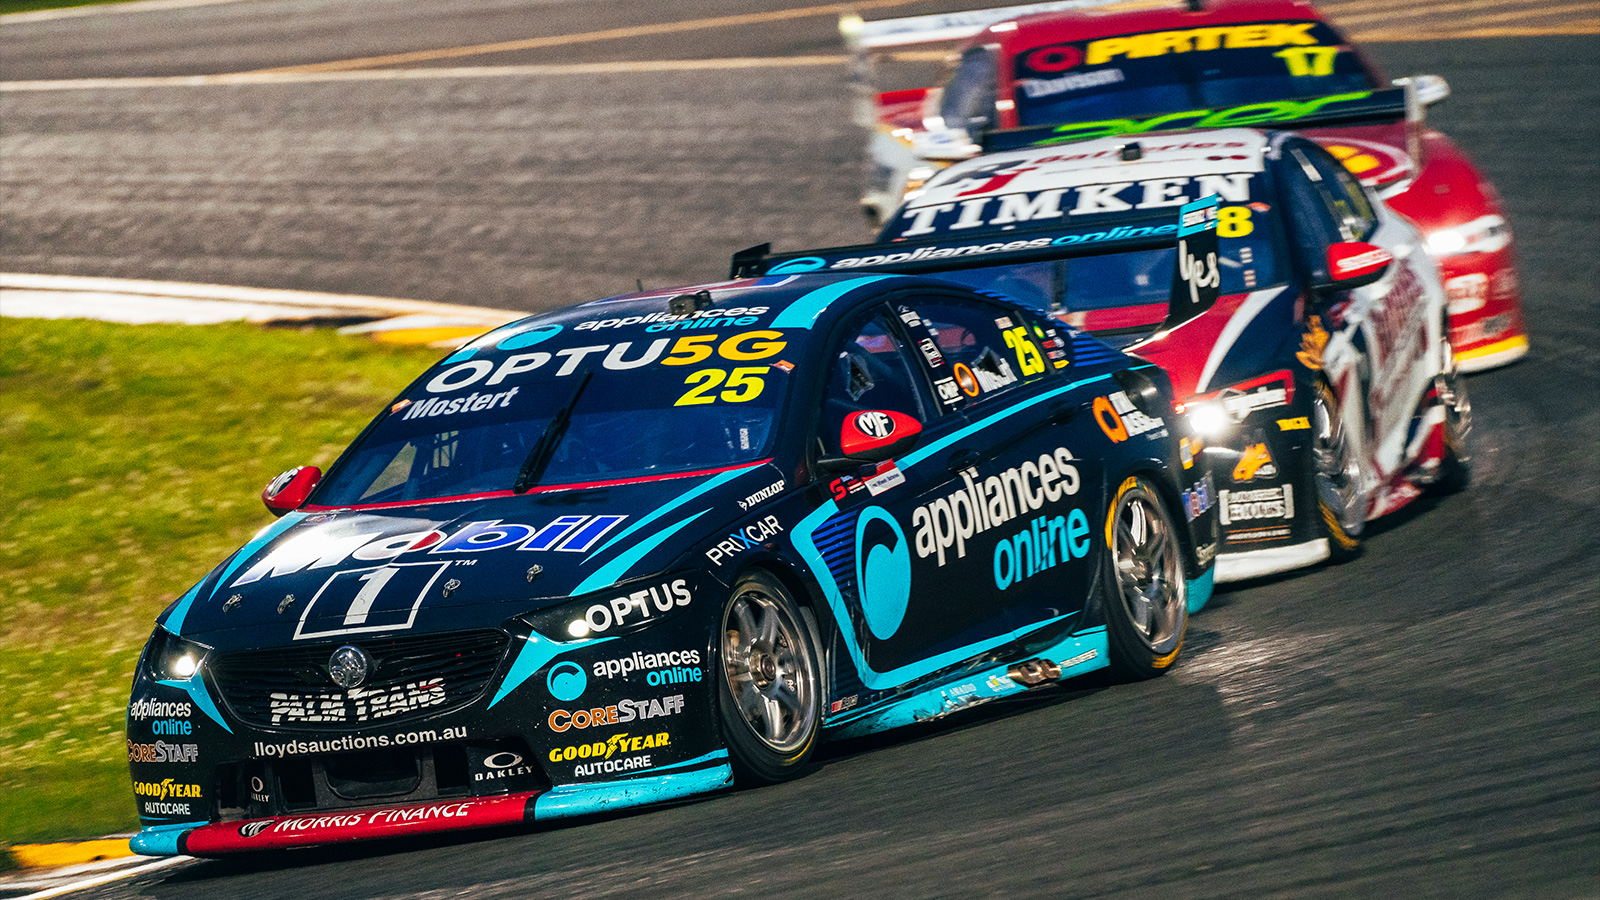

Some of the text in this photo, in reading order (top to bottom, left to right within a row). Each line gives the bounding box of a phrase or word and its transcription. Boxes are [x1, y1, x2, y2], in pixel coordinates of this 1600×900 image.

[1086, 24, 1319, 66] PIRTEK
[1272, 46, 1338, 77] 17
[901, 174, 1254, 237] TIMKEN
[1215, 206, 1254, 238] 8
[831, 224, 1178, 269] appliances online
[574, 306, 770, 331] appliances
[645, 316, 759, 333] online
[1002, 326, 1046, 377] 25
[673, 366, 771, 407] 25
[402, 386, 520, 421] Mostert
[745, 479, 785, 508] DUNLOP
[912, 447, 1081, 567] appliances
[229, 515, 630, 588] Mobil
[705, 514, 784, 566] PRIXCAR
[993, 508, 1091, 591] online
[455, 559, 478, 567] TM
[343, 567, 401, 626] 1
[585, 579, 692, 633] OPTUS
[593, 649, 701, 680] appliances
[647, 666, 702, 687] online
[130, 698, 192, 723] appliances
[152, 717, 193, 736] online
[254, 726, 467, 759] lloydsauctions.com.au
[549, 732, 672, 763] GOODYEAR
[474, 765, 534, 782] OAKLEY
[575, 755, 652, 777] AUTOCARE
[134, 779, 203, 801] GOODYEAR
[145, 801, 191, 815] AUTOCARE
[274, 812, 361, 833] MORRIS
[368, 801, 478, 824] FINANCE
